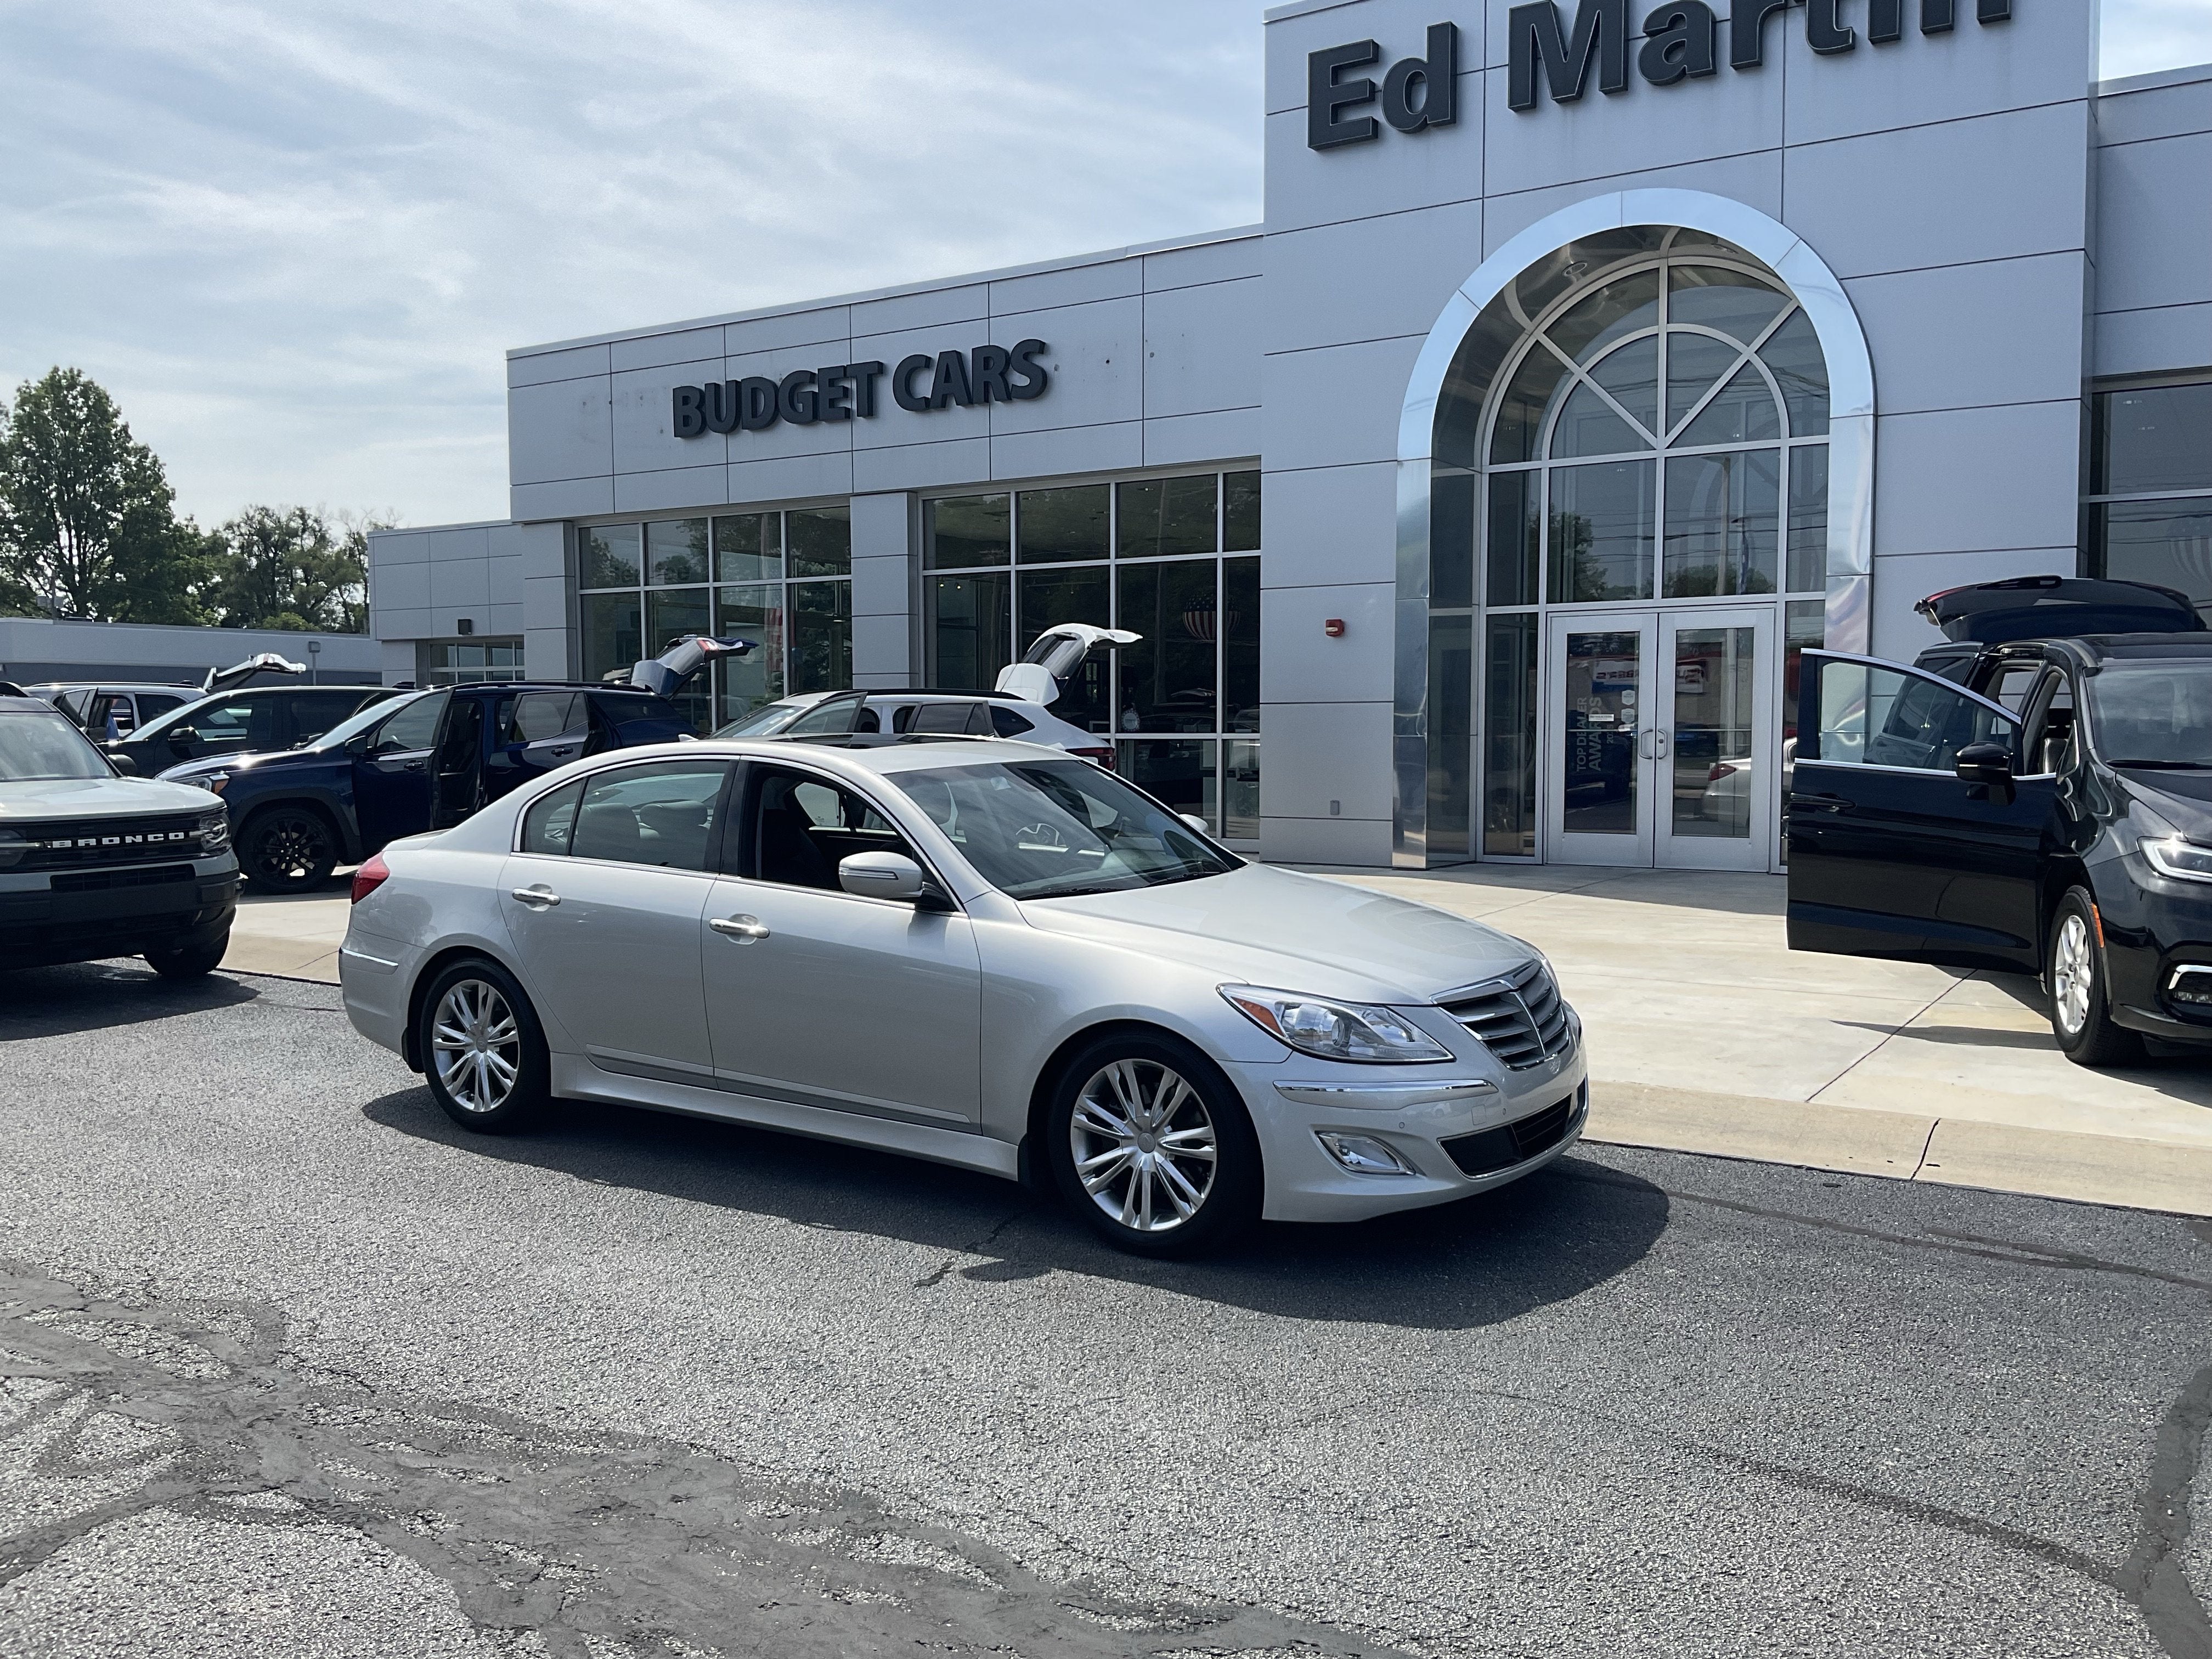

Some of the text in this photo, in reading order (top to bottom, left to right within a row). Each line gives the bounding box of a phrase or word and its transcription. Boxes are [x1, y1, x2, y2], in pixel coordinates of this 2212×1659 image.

[1308, 21, 1457, 151] Ed
[673, 338, 1048, 438] BUDGET CARS
[1577, 697, 1587, 772] TOP DEALER
[53, 832, 184, 848] BRONCO
